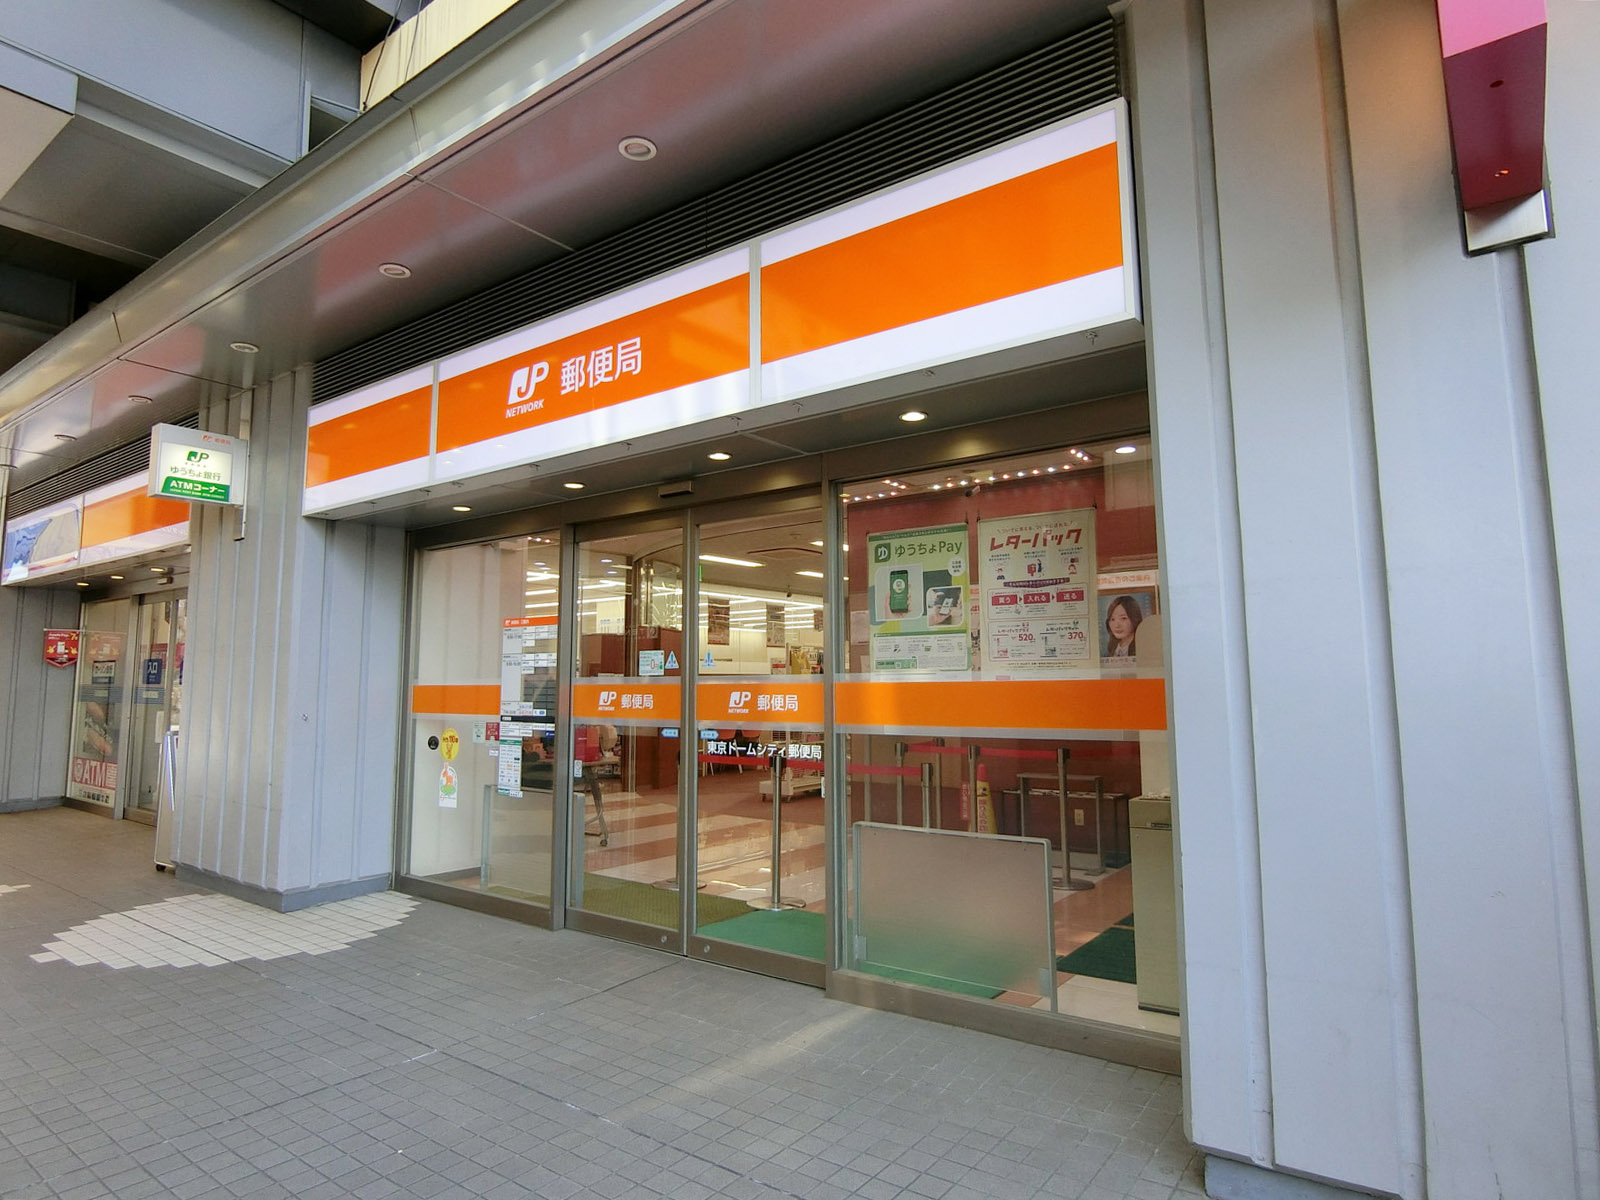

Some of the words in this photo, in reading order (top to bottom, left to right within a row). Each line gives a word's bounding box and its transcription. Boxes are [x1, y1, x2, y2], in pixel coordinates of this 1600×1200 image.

[560, 336, 643, 396] 郵便局
[508, 361, 549, 405] JP
[505, 399, 545, 419] NETWORK
[187, 451, 209, 462] JP
[170, 466, 221, 481] ゆうちょ銀行
[170, 480, 225, 493] ATMコーナー
[990, 528, 1082, 551] レターパック
[895, 541, 962, 557] ゆうちょPay
[1027, 595, 1047, 603] 入れる
[1063, 592, 1078, 600] 送る
[1018, 633, 1034, 641] 520
[1067, 631, 1084, 640] 370
[147, 661, 158, 674] 入口
[598, 691, 617, 706] JP
[621, 694, 653, 709] 郵便局
[729, 691, 751, 707] JP
[757, 694, 799, 711] 郵便局
